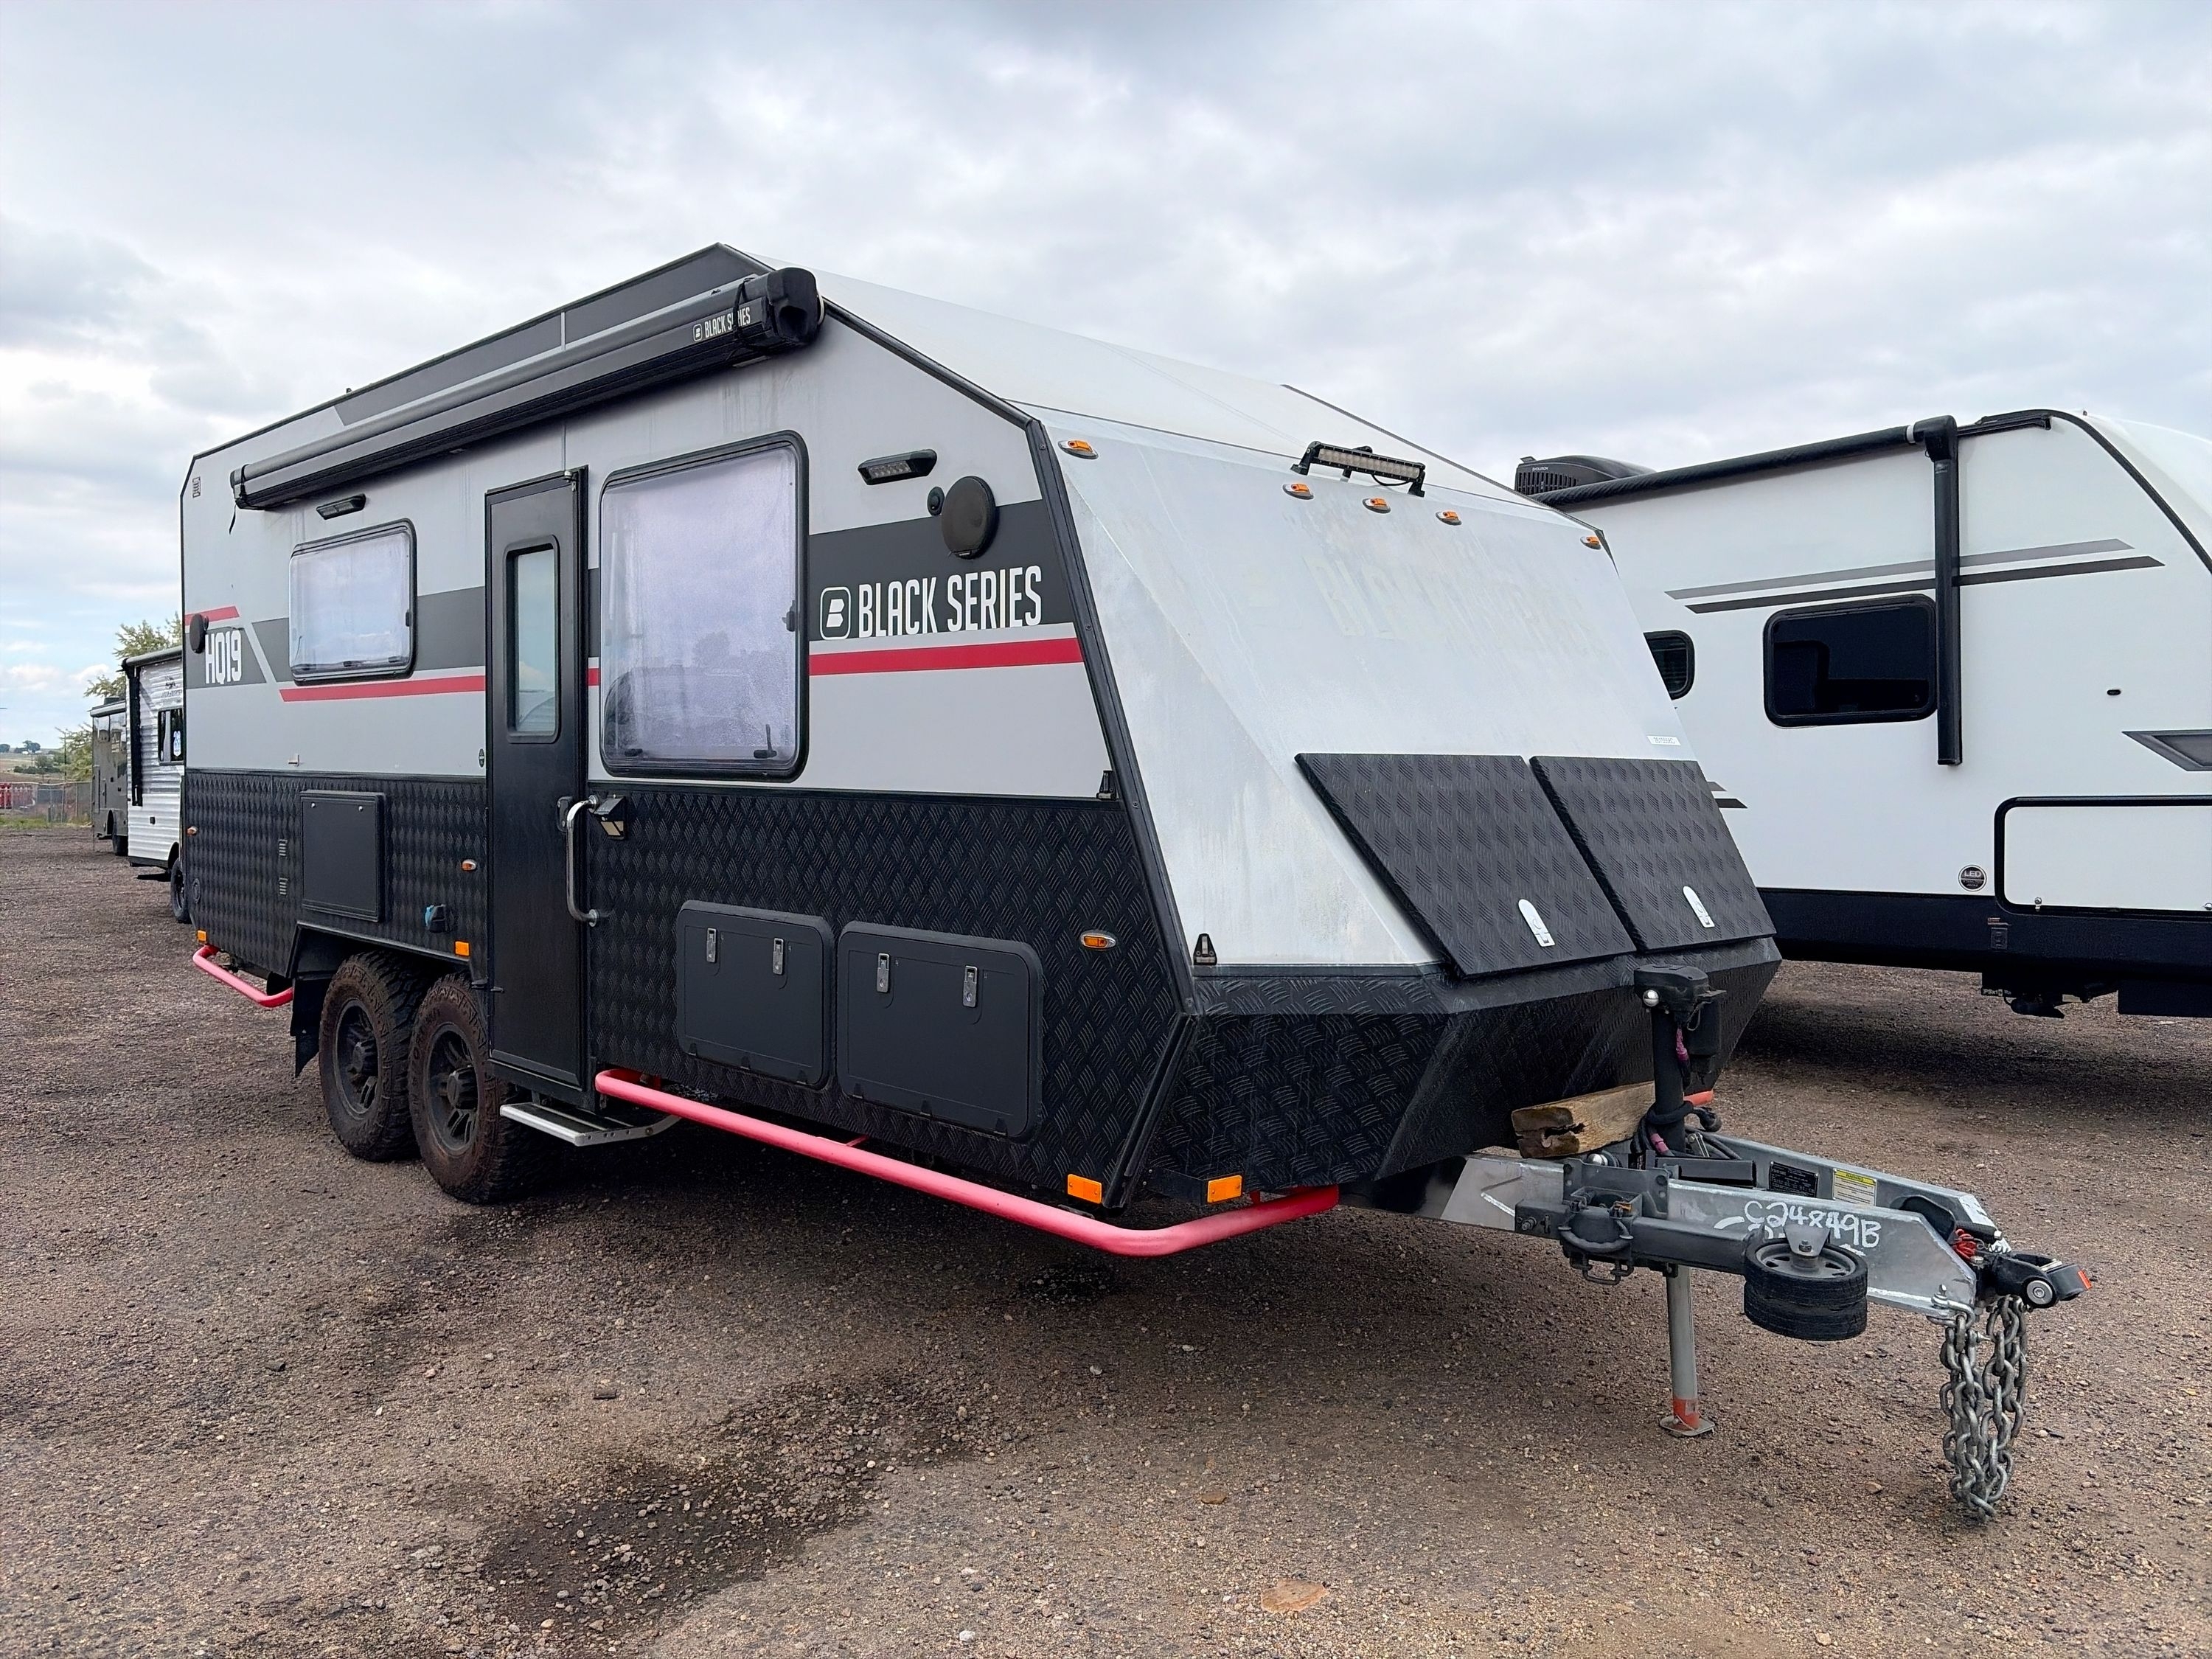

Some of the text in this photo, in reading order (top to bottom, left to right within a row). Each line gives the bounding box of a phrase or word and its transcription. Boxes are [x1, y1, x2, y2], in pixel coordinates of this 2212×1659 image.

[704, 315, 726, 338] BLACK
[727, 307, 751, 330] SIES
[858, 577, 938, 639] BLACK
[947, 565, 1042, 632] SERIES
[204, 630, 242, 685] HQ19
